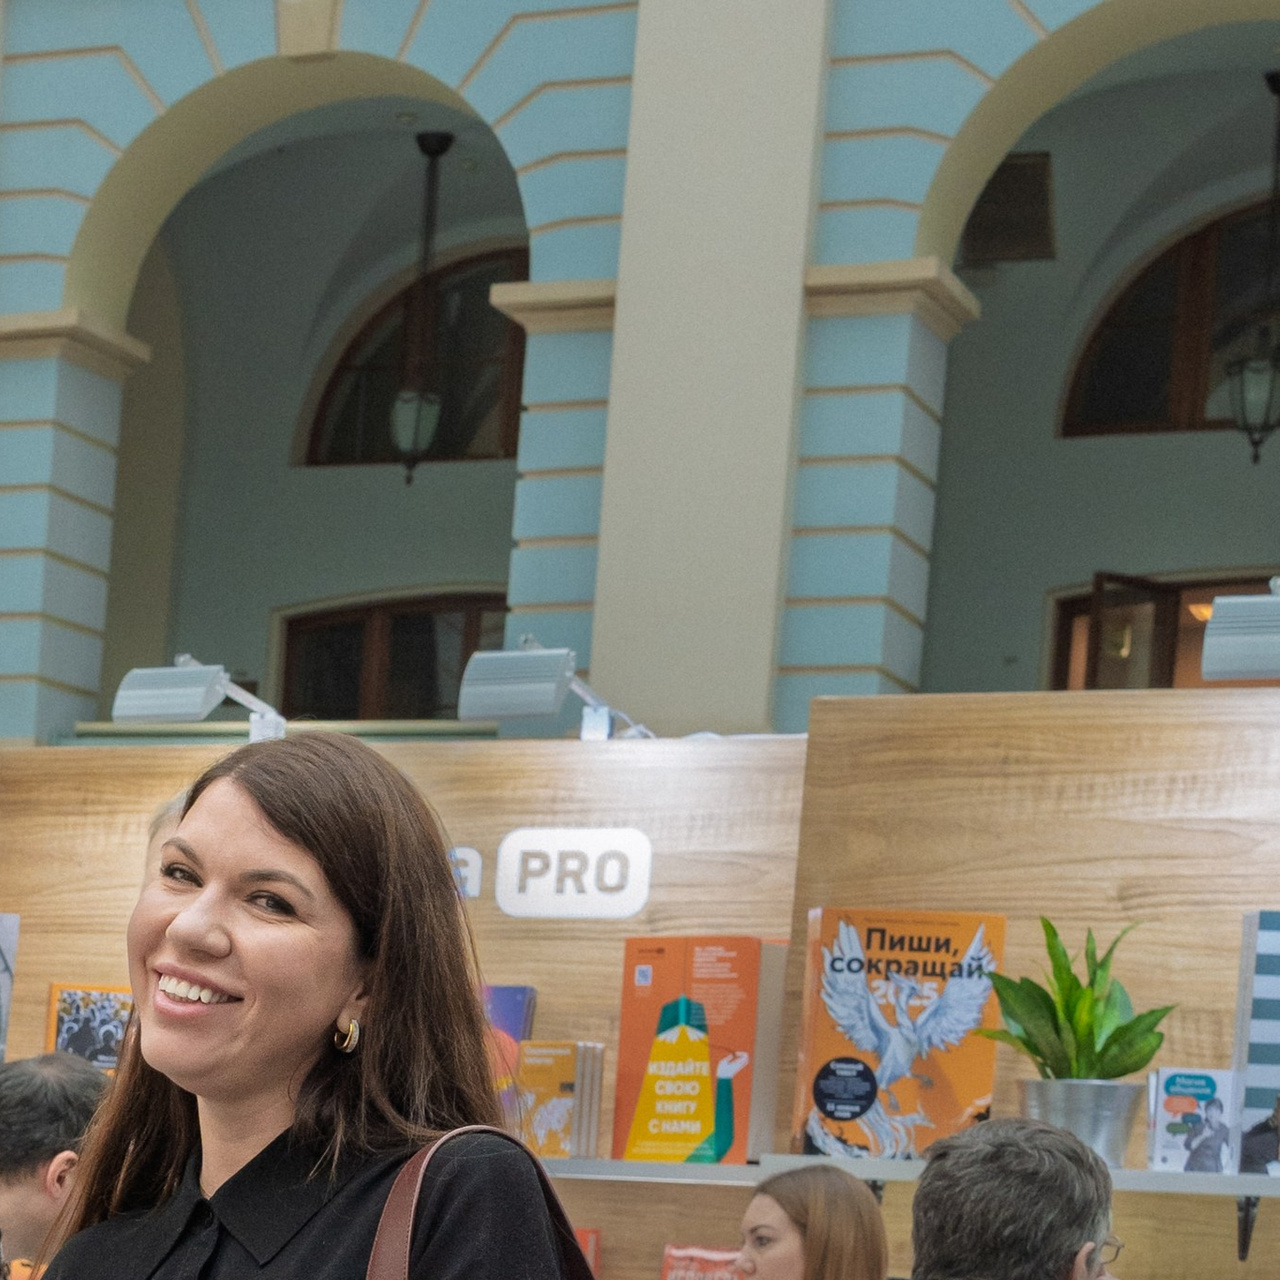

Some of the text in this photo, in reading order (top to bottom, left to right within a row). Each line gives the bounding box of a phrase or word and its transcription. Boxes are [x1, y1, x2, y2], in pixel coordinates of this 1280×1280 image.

[518, 849, 629, 894] PRO
[866, 927, 959, 956] Пиши,
[830, 955, 984, 981] сокращай
[648, 1059, 709, 1078] ИЗДАЙТЕ
[654, 1080, 700, 1096] СВОЮ
[655, 1099, 697, 1115] КНИГУ
[661, 1119, 701, 1134] НАМИ
